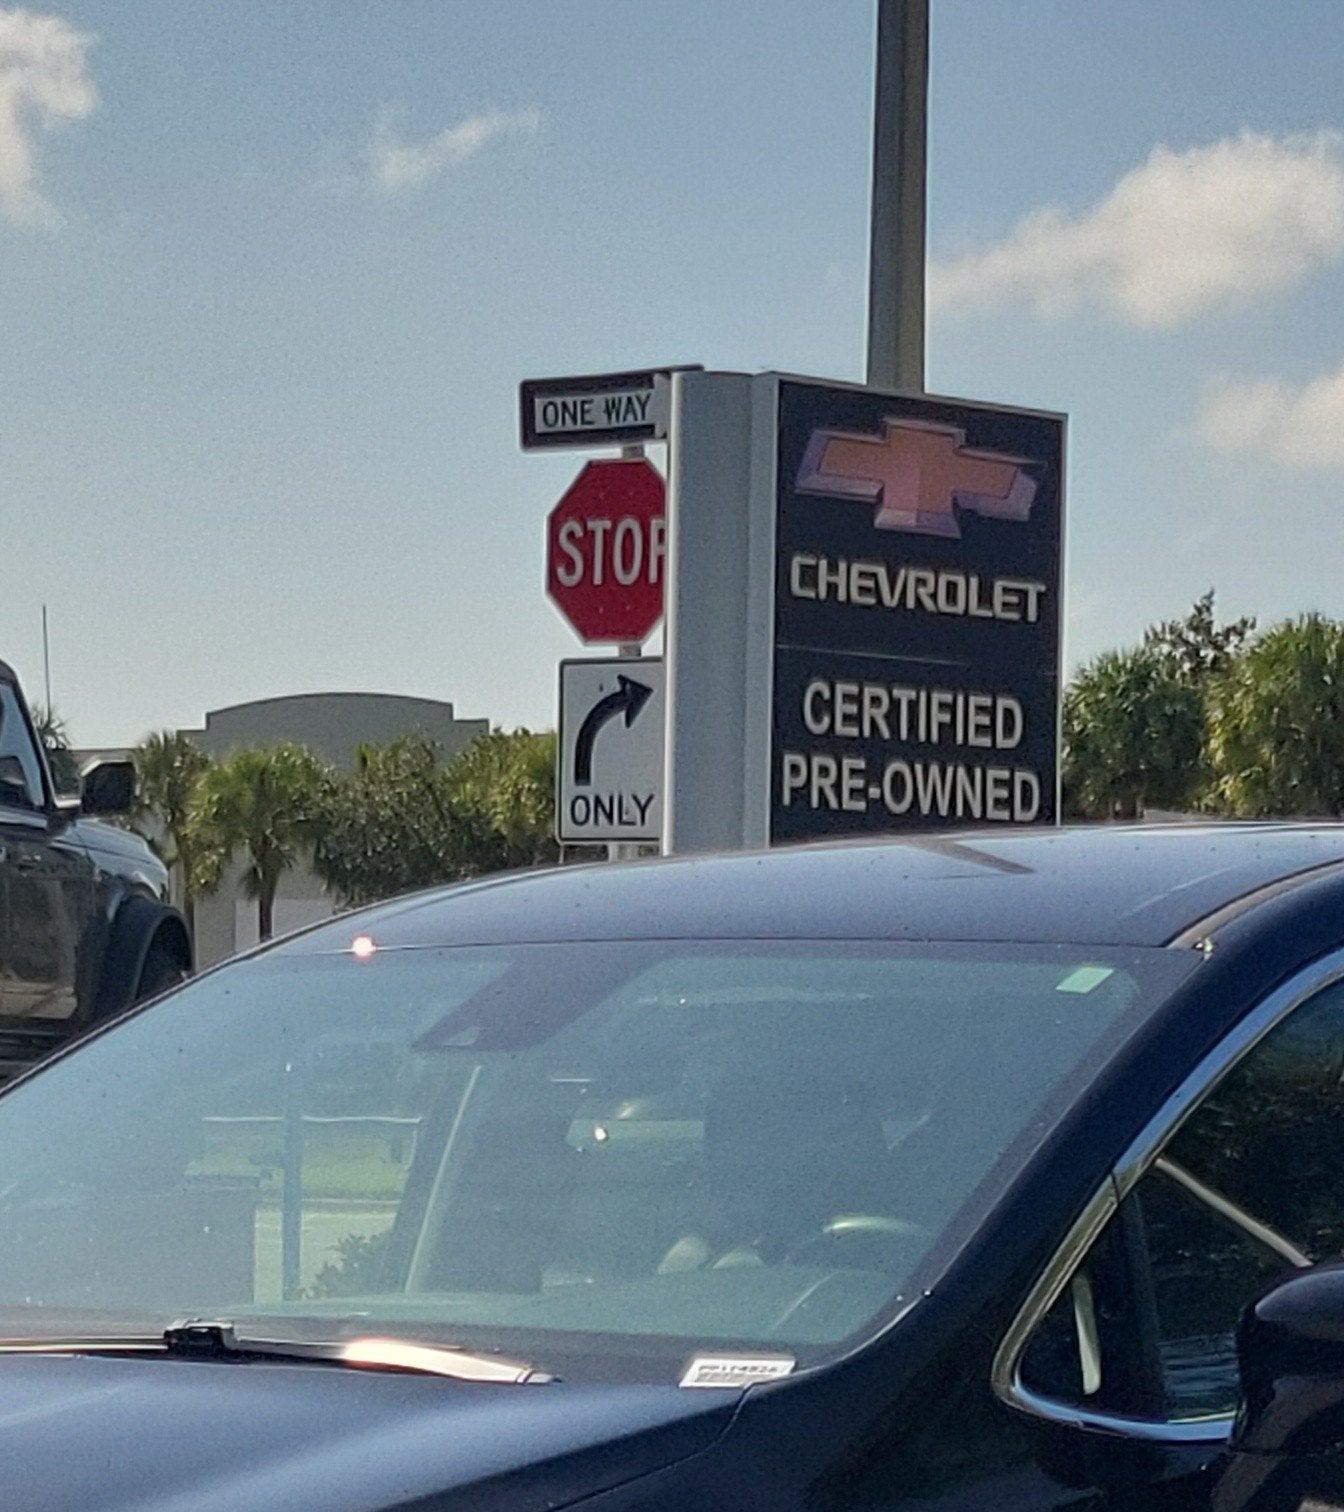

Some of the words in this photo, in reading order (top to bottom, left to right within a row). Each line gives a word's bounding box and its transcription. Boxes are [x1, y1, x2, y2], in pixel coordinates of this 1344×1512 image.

[542, 399, 595, 428] ONE
[603, 392, 651, 424] WAY
[790, 555, 1047, 623] CHEVROLET
[803, 681, 1024, 750] CERTIFIED
[570, 793, 654, 827] ONLY
[781, 753, 1041, 823] PRE-OWNED
